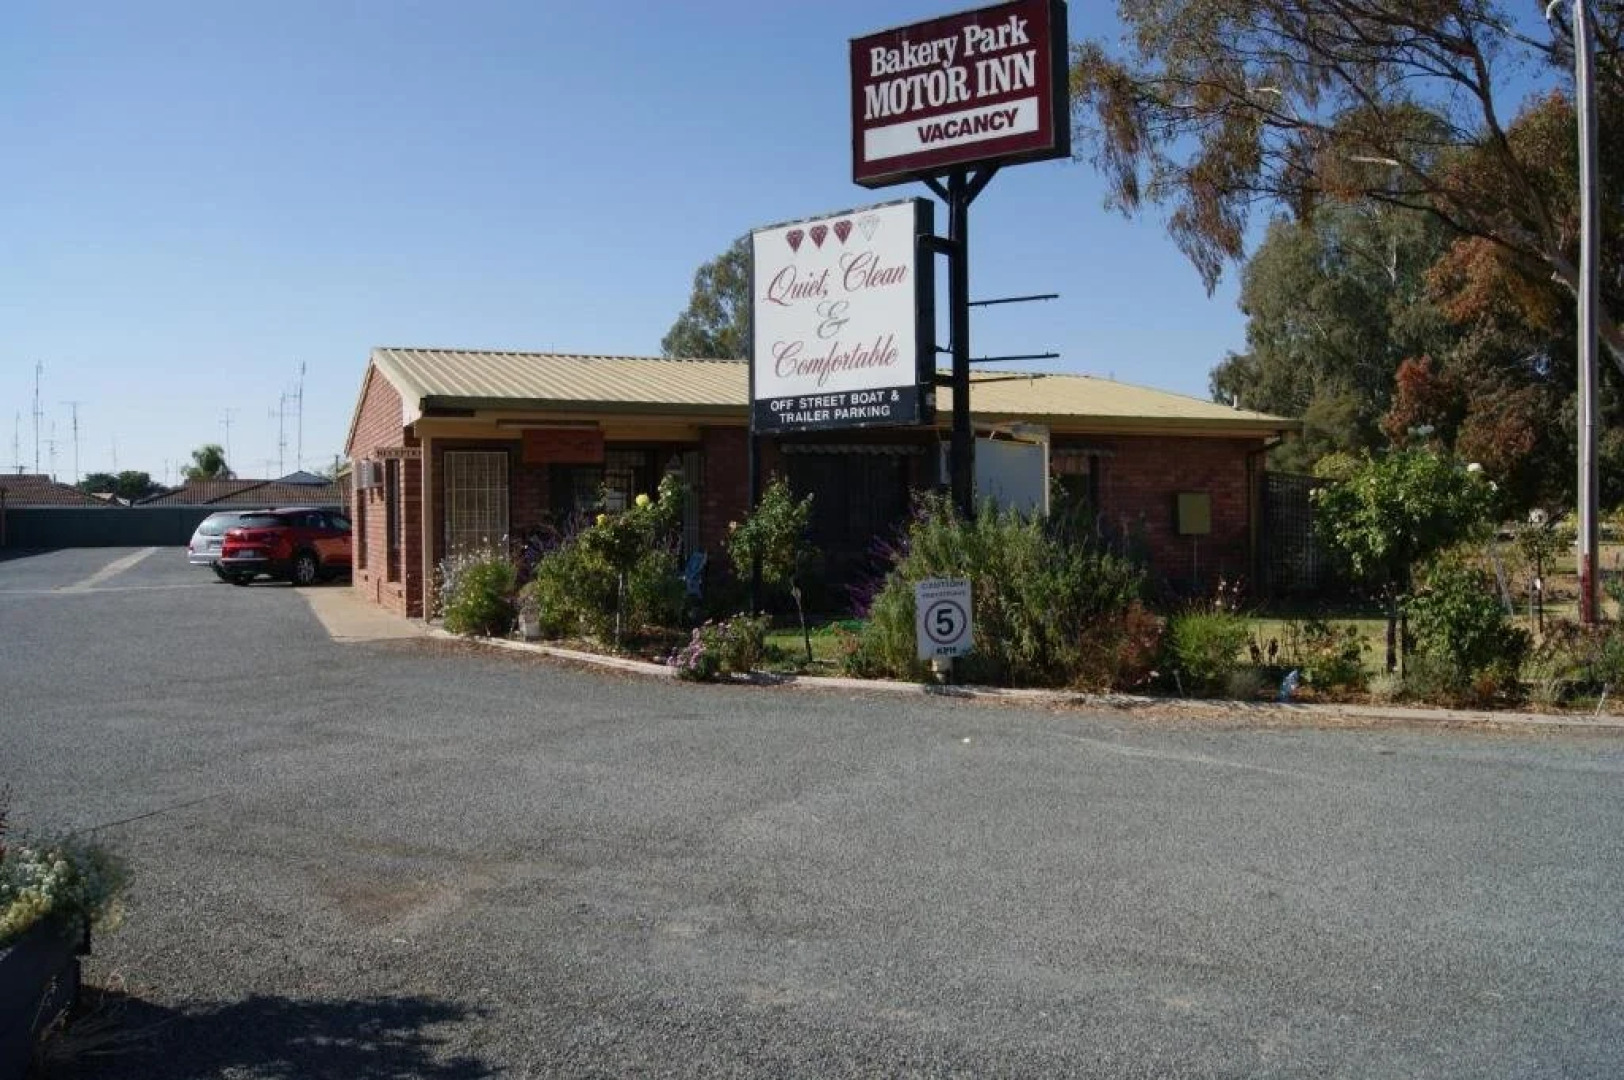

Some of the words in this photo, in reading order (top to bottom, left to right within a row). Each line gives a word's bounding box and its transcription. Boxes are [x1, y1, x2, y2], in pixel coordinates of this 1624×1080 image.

[870, 36, 959, 77] Bakery
[963, 15, 1029, 57] Park
[864, 66, 971, 120] MOTOR
[976, 50, 1037, 98] INN
[917, 107, 1018, 144] VACANCY
[763, 264, 829, 306] Quiet,
[840, 251, 908, 292] Clean
[816, 300, 850, 339] &
[772, 334, 898, 388] Comfortable
[770, 400, 793, 412] OFF
[800, 395, 846, 409] STREET
[851, 391, 885, 405] BOAT
[890, 389, 900, 401] &
[779, 410, 830, 424] TRAILER
[833, 405, 891, 420] PARKING
[936, 608, 954, 636] 5
